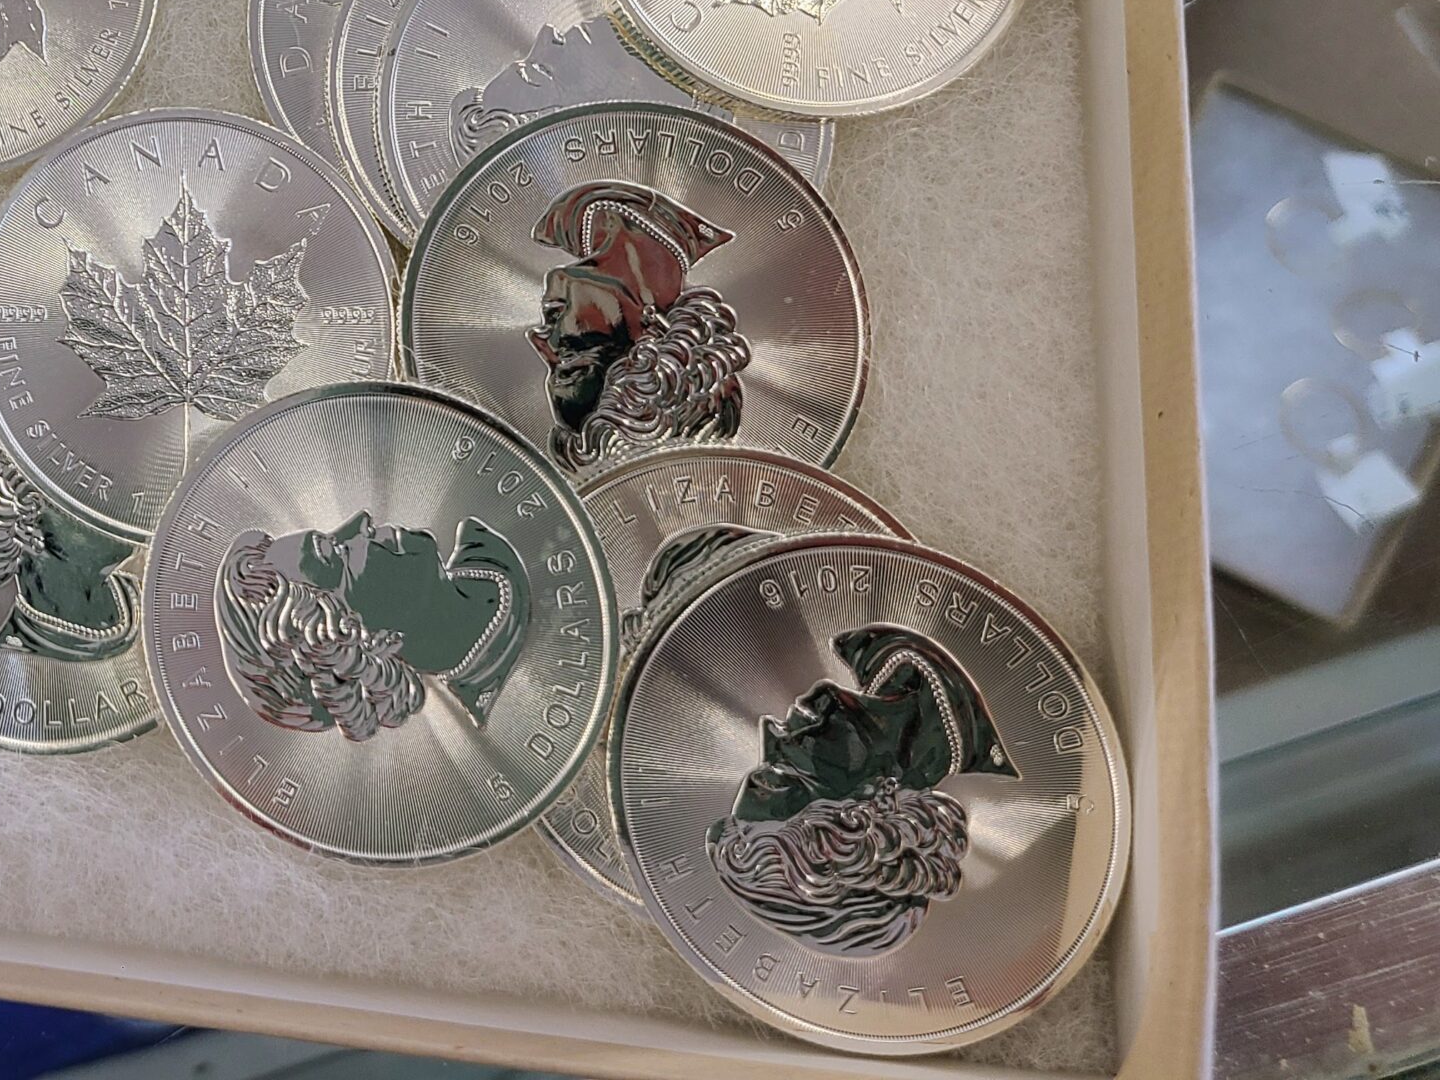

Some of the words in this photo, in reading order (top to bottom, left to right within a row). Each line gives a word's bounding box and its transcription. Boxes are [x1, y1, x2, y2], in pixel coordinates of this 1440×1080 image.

[55, 26, 121, 112] SILVER
[818, 56, 892, 90] FINE
[32, 135, 333, 237] CANADA
[454, 161, 534, 247] 2016
[563, 127, 765, 195] DOLLARS
[776, 207, 804, 233] 5
[26, 419, 114, 503] SILVER
[228, 449, 271, 490] II
[450, 434, 549, 520] 2016
[760, 564, 872, 609] 2016
[173, 513, 302, 810] ELIZABETH
[524, 550, 591, 759] DOLLARS
[914, 578, 1085, 756] DOLLARS
[485, 776, 513, 803] 5
[661, 854, 976, 1015] ELIZABETH
